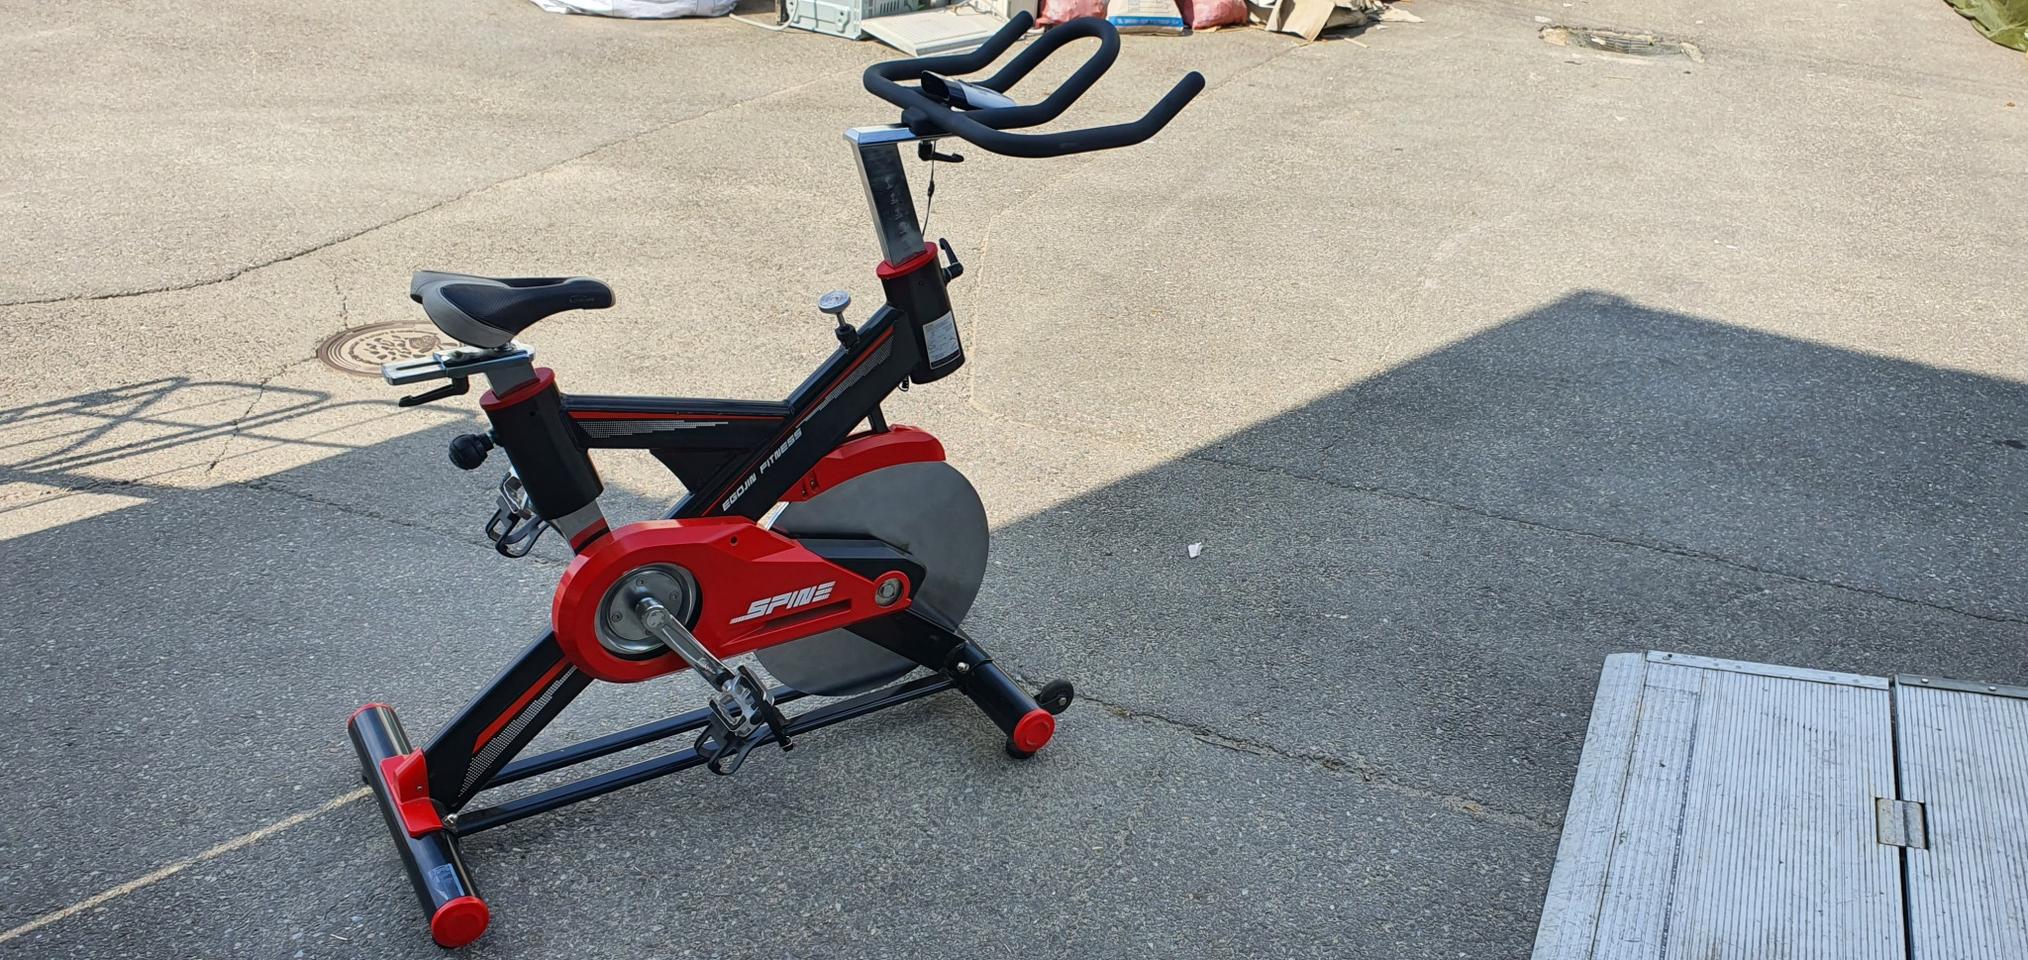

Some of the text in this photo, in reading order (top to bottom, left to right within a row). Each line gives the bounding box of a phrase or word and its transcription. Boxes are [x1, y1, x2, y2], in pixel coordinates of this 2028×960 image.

[722, 428, 803, 512] EGOJIN FITNESS
[729, 581, 836, 624] SPINE
